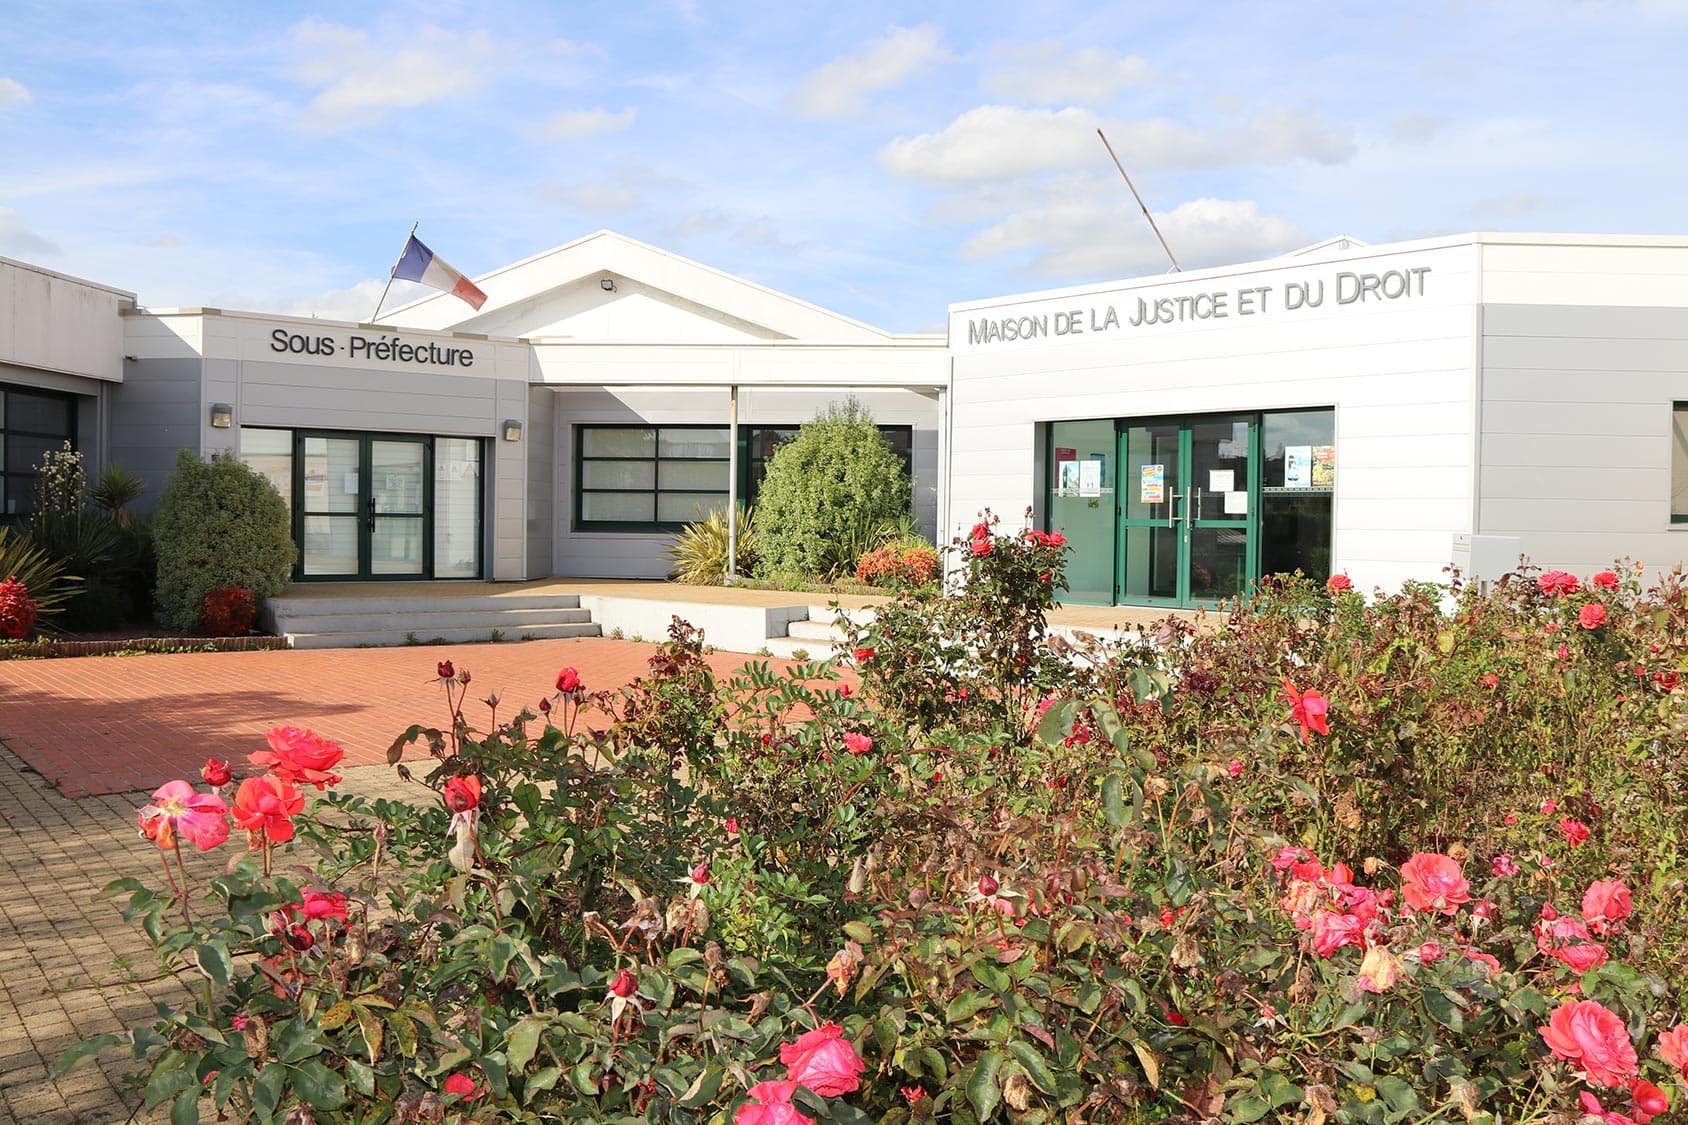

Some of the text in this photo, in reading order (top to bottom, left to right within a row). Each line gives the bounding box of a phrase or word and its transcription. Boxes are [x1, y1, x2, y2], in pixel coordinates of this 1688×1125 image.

[968, 267, 1432, 345] MAISON DE LA JUSTICE ET DU DROIT
[271, 329, 335, 356] Sous
[350, 335, 474, 367] Préfecture
